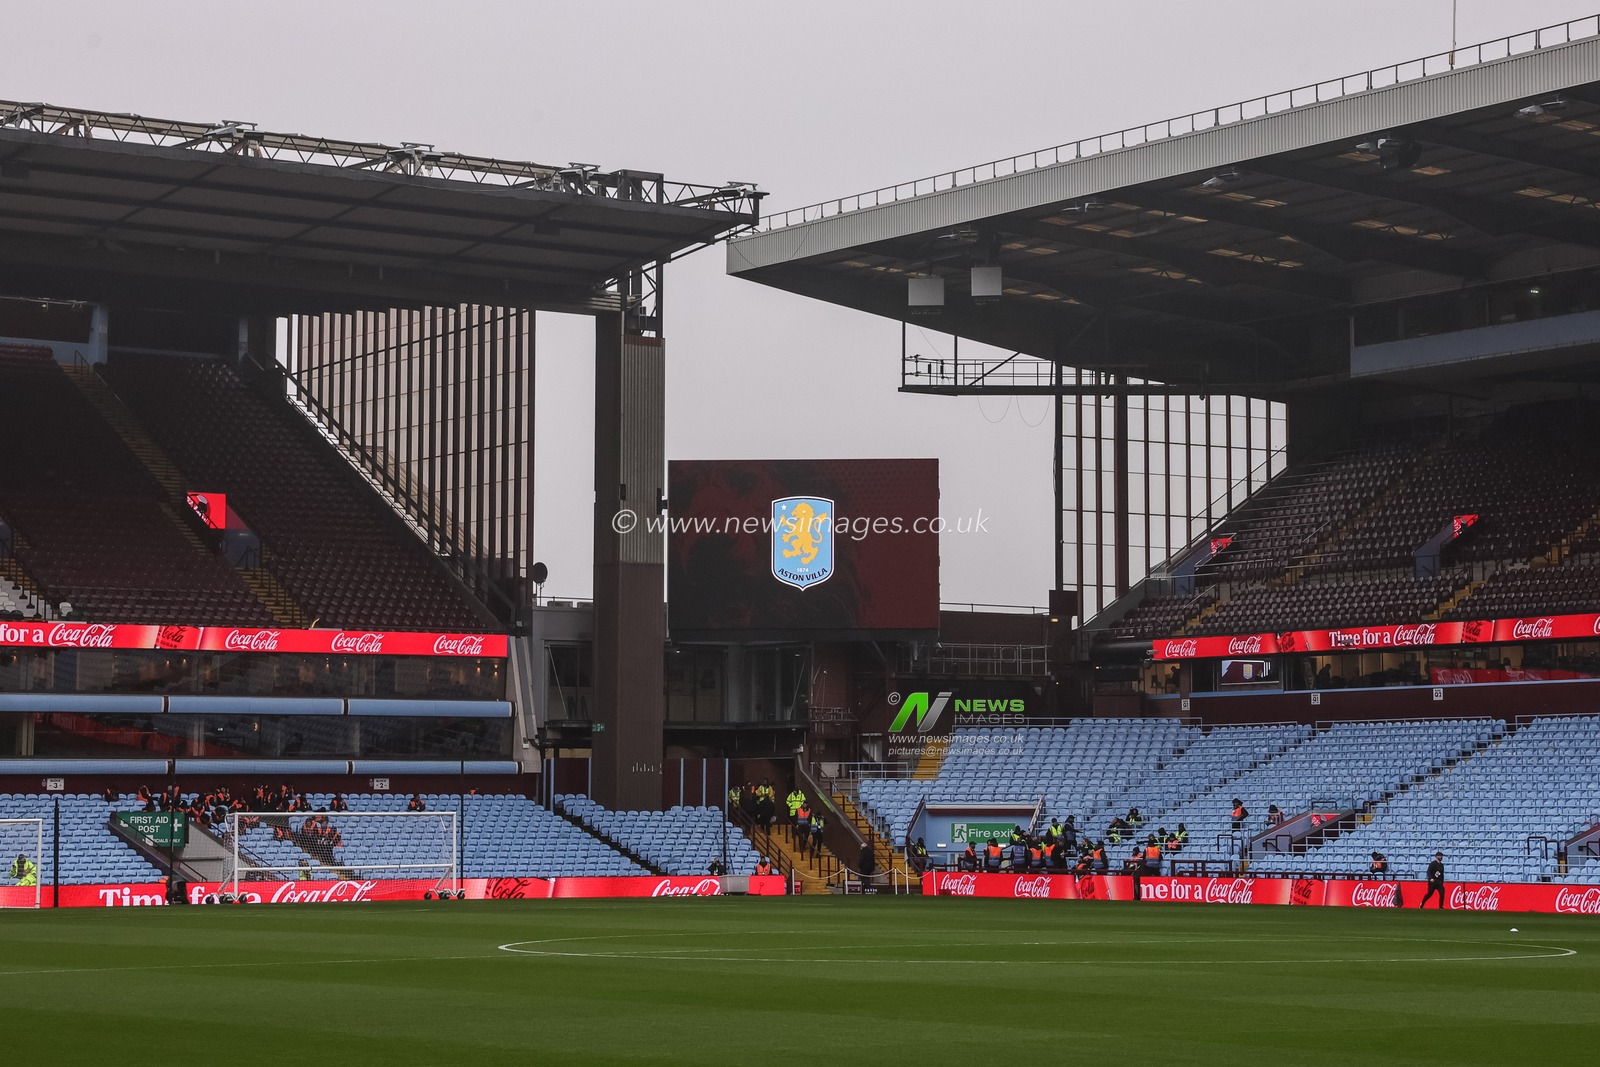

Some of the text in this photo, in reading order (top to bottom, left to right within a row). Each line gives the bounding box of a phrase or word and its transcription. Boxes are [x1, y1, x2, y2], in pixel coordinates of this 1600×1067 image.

[778, 567, 828, 581] ASTON VILLA
[0, 623, 117, 648] for a Coca-Cola
[1329, 623, 1437, 647] Time for a Coca-Cola
[1513, 617, 1555, 639] Coca-Cola
[225, 629, 281, 651] Coca-Cola
[331, 631, 385, 653] Coca-Cola
[433, 634, 485, 656] Coca-Cola
[1165, 639, 1198, 658] Coca-Cola
[1228, 635, 1262, 655] Coca-Cola
[129, 816, 169, 824] FIRST AID
[138, 825, 160, 833] POST
[968, 828, 1015, 838] Fire exit
[100, 886, 170, 906] Tim
[1014, 876, 1052, 898] Coca-Cola
[1170, 879, 1192, 899] for
[1193, 884, 1203, 900] a
[1205, 877, 1255, 905] Coca-Cola
[1450, 885, 1501, 911] Coca-Cola
[1555, 887, 1600, 914] Coca-Col
